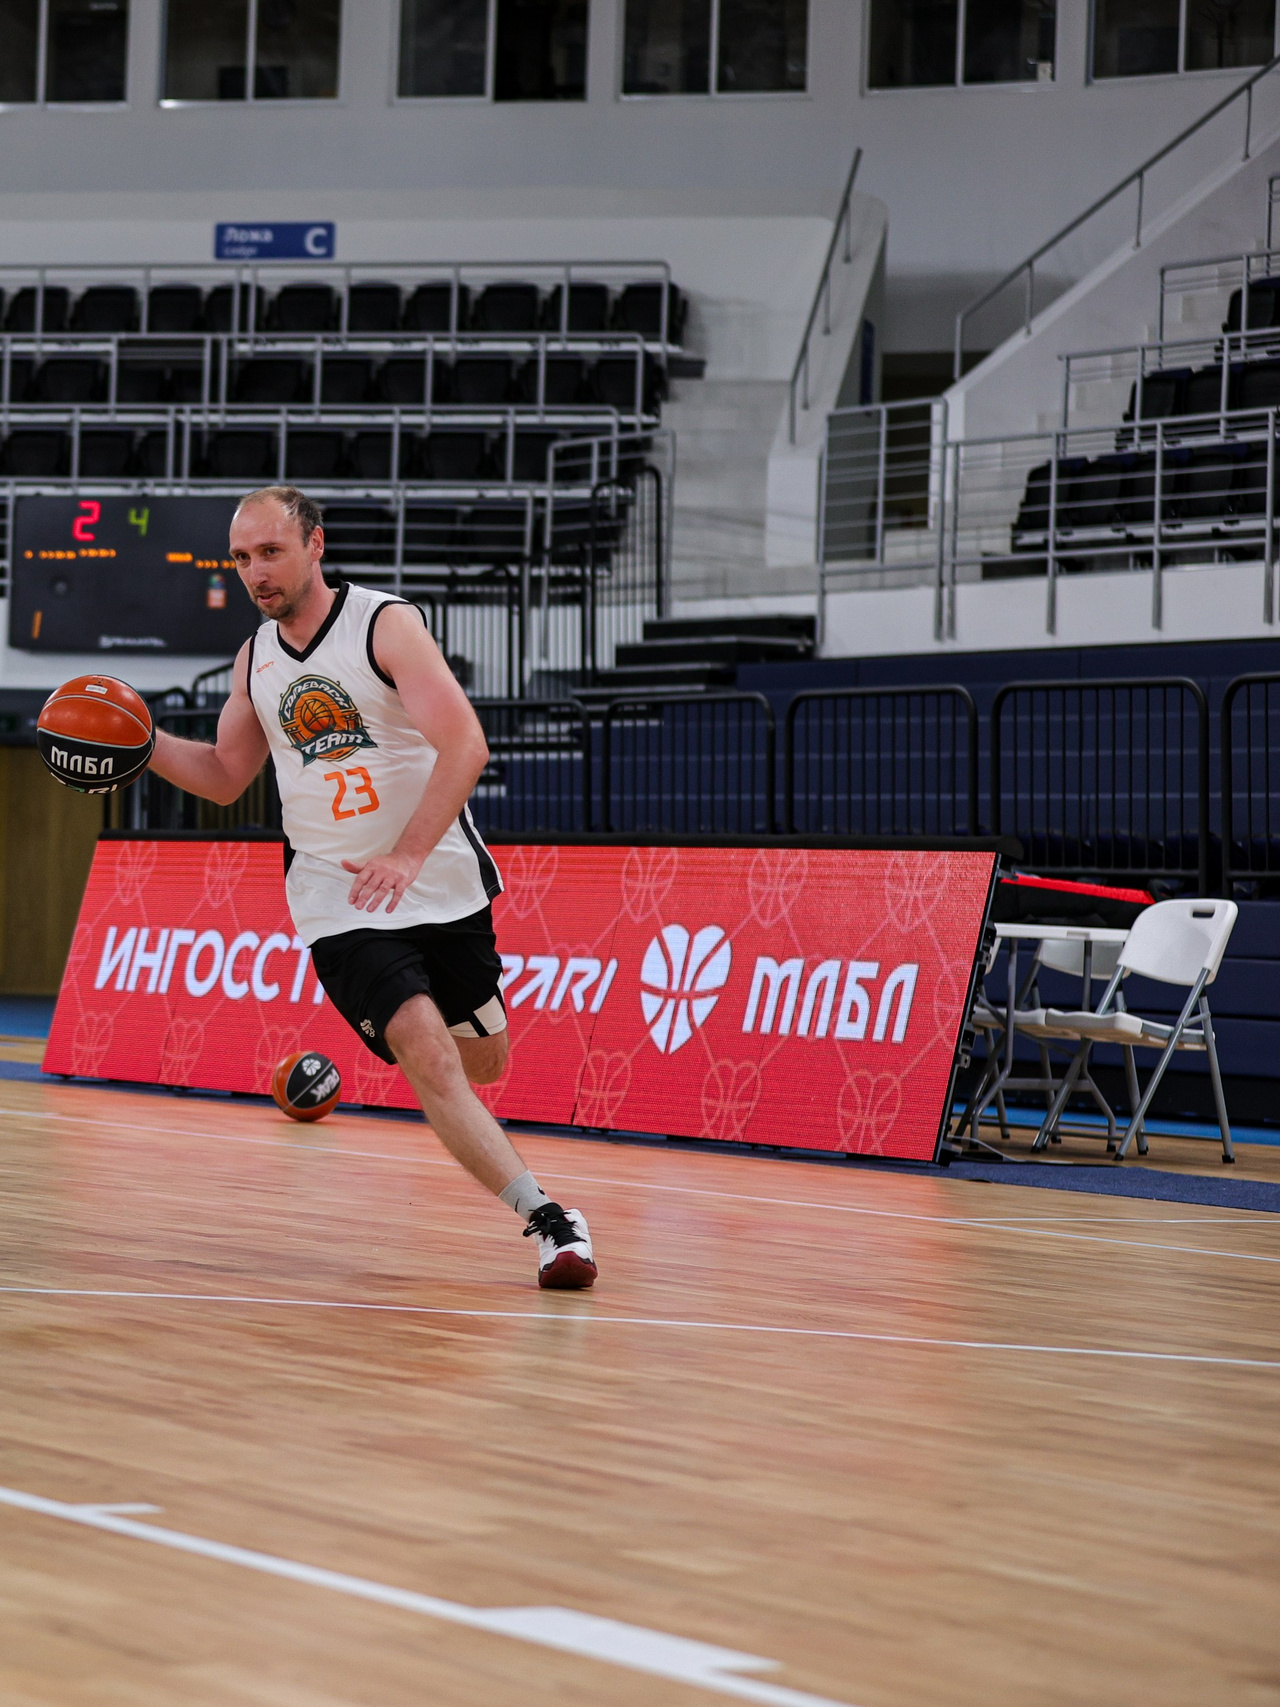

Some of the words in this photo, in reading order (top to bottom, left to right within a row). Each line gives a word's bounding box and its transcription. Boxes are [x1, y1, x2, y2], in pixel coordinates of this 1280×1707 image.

[72, 500, 102, 542] 2
[128, 507, 150, 537] 4
[283, 680, 350, 720] COMEBACK
[301, 732, 364, 756] TEAM
[323, 766, 380, 821] 23
[94, 926, 325, 1005] ИНГОССТ
[742, 956, 919, 1044] МЛБЛ
[310, 1067, 341, 1103] PEAK
